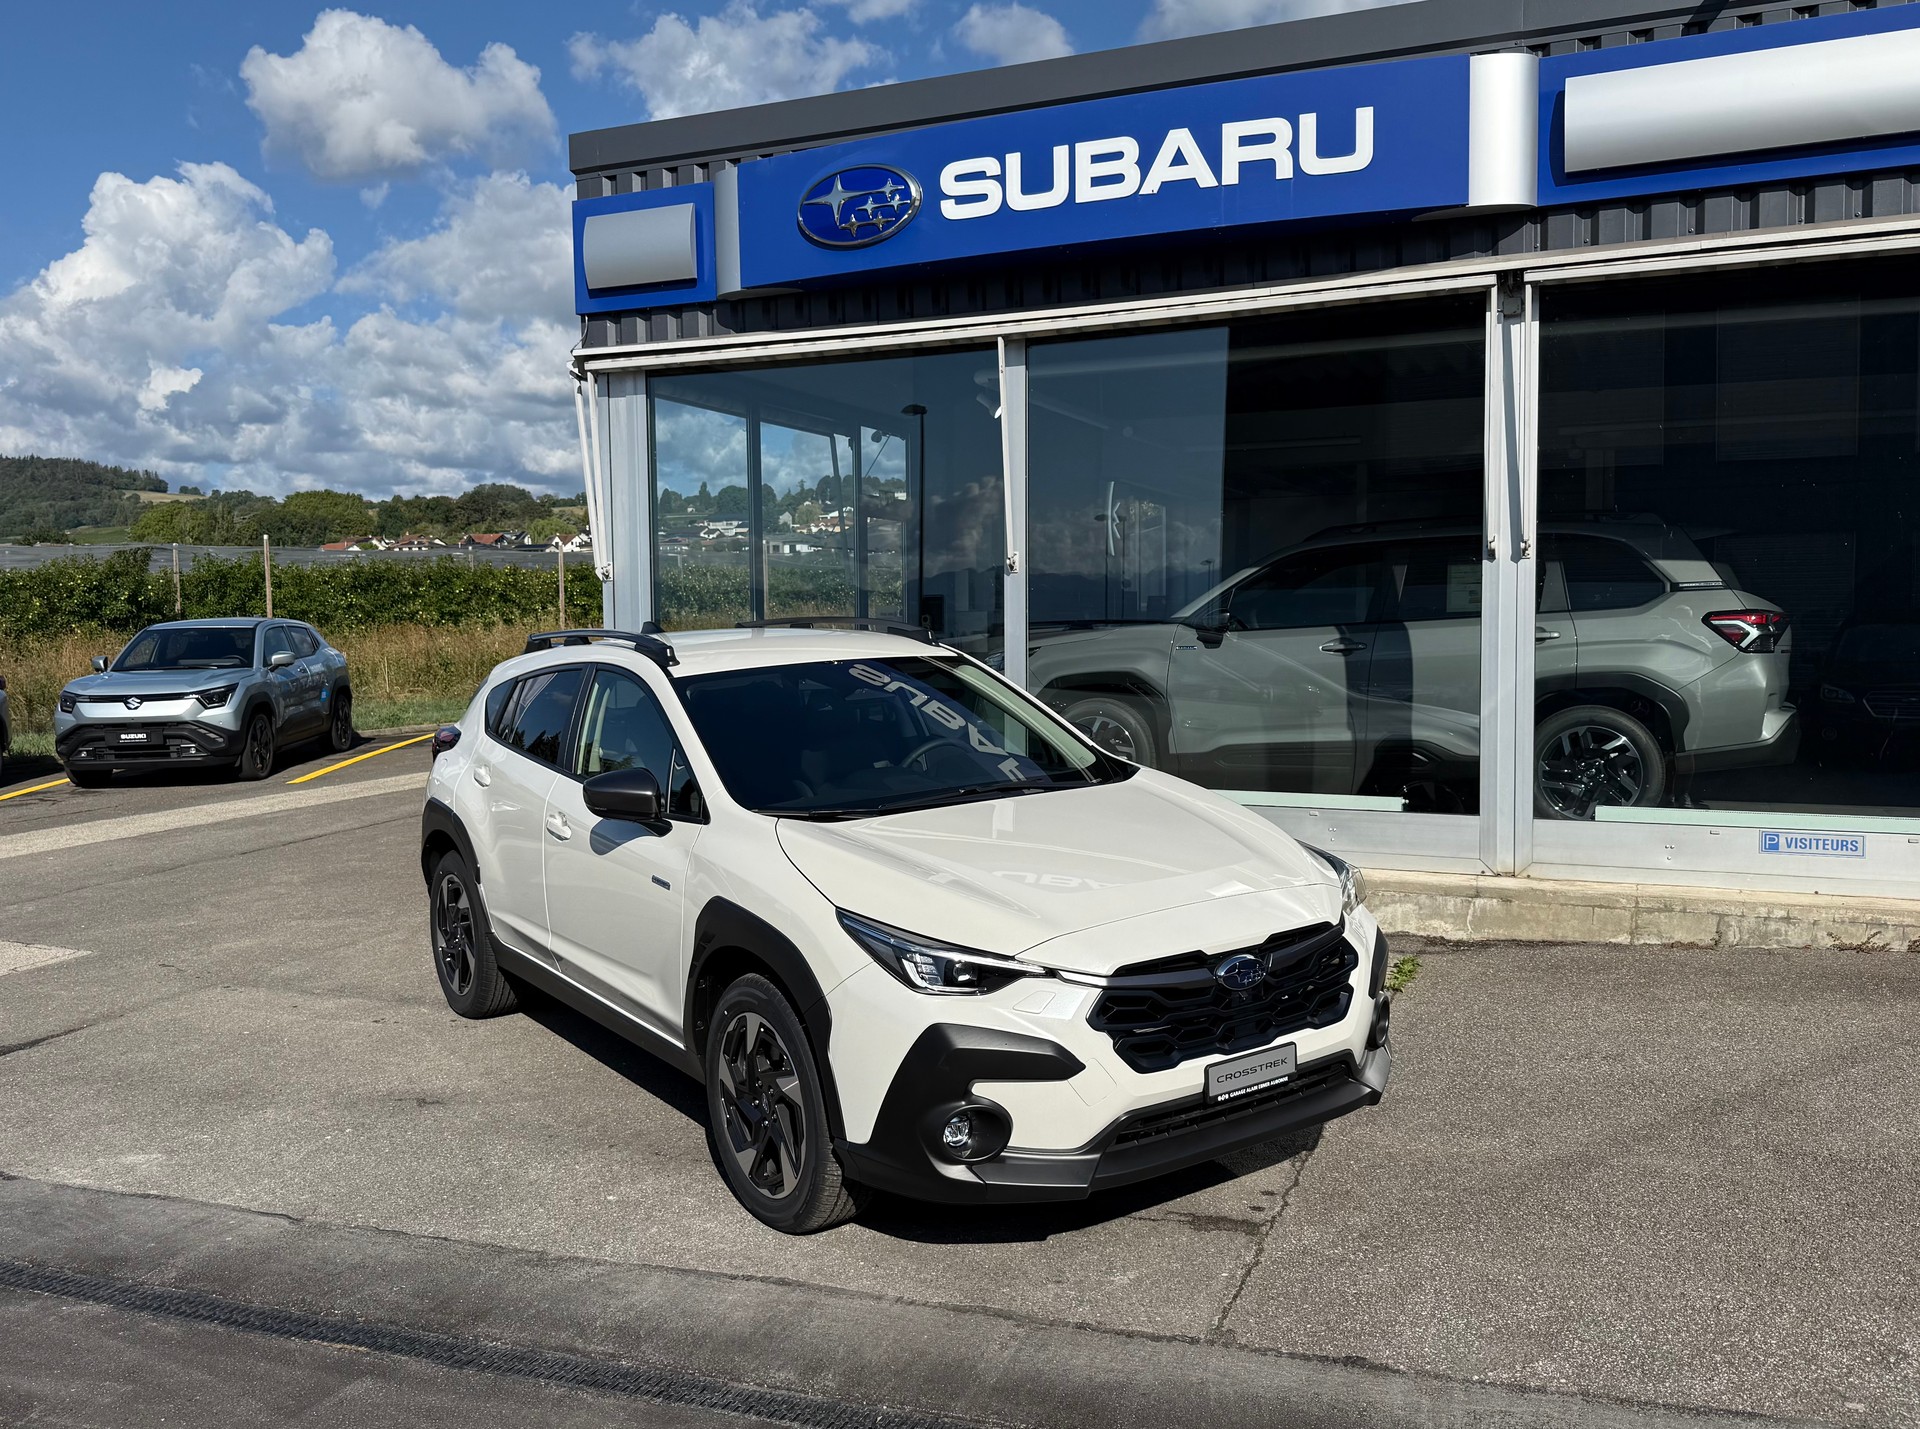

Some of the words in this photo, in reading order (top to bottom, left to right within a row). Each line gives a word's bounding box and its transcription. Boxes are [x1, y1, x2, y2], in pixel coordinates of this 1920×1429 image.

[939, 106, 1375, 221] SUBARU
[1784, 837, 1859, 852] VISITEURS
[1216, 1057, 1288, 1084] CROSSTREK
